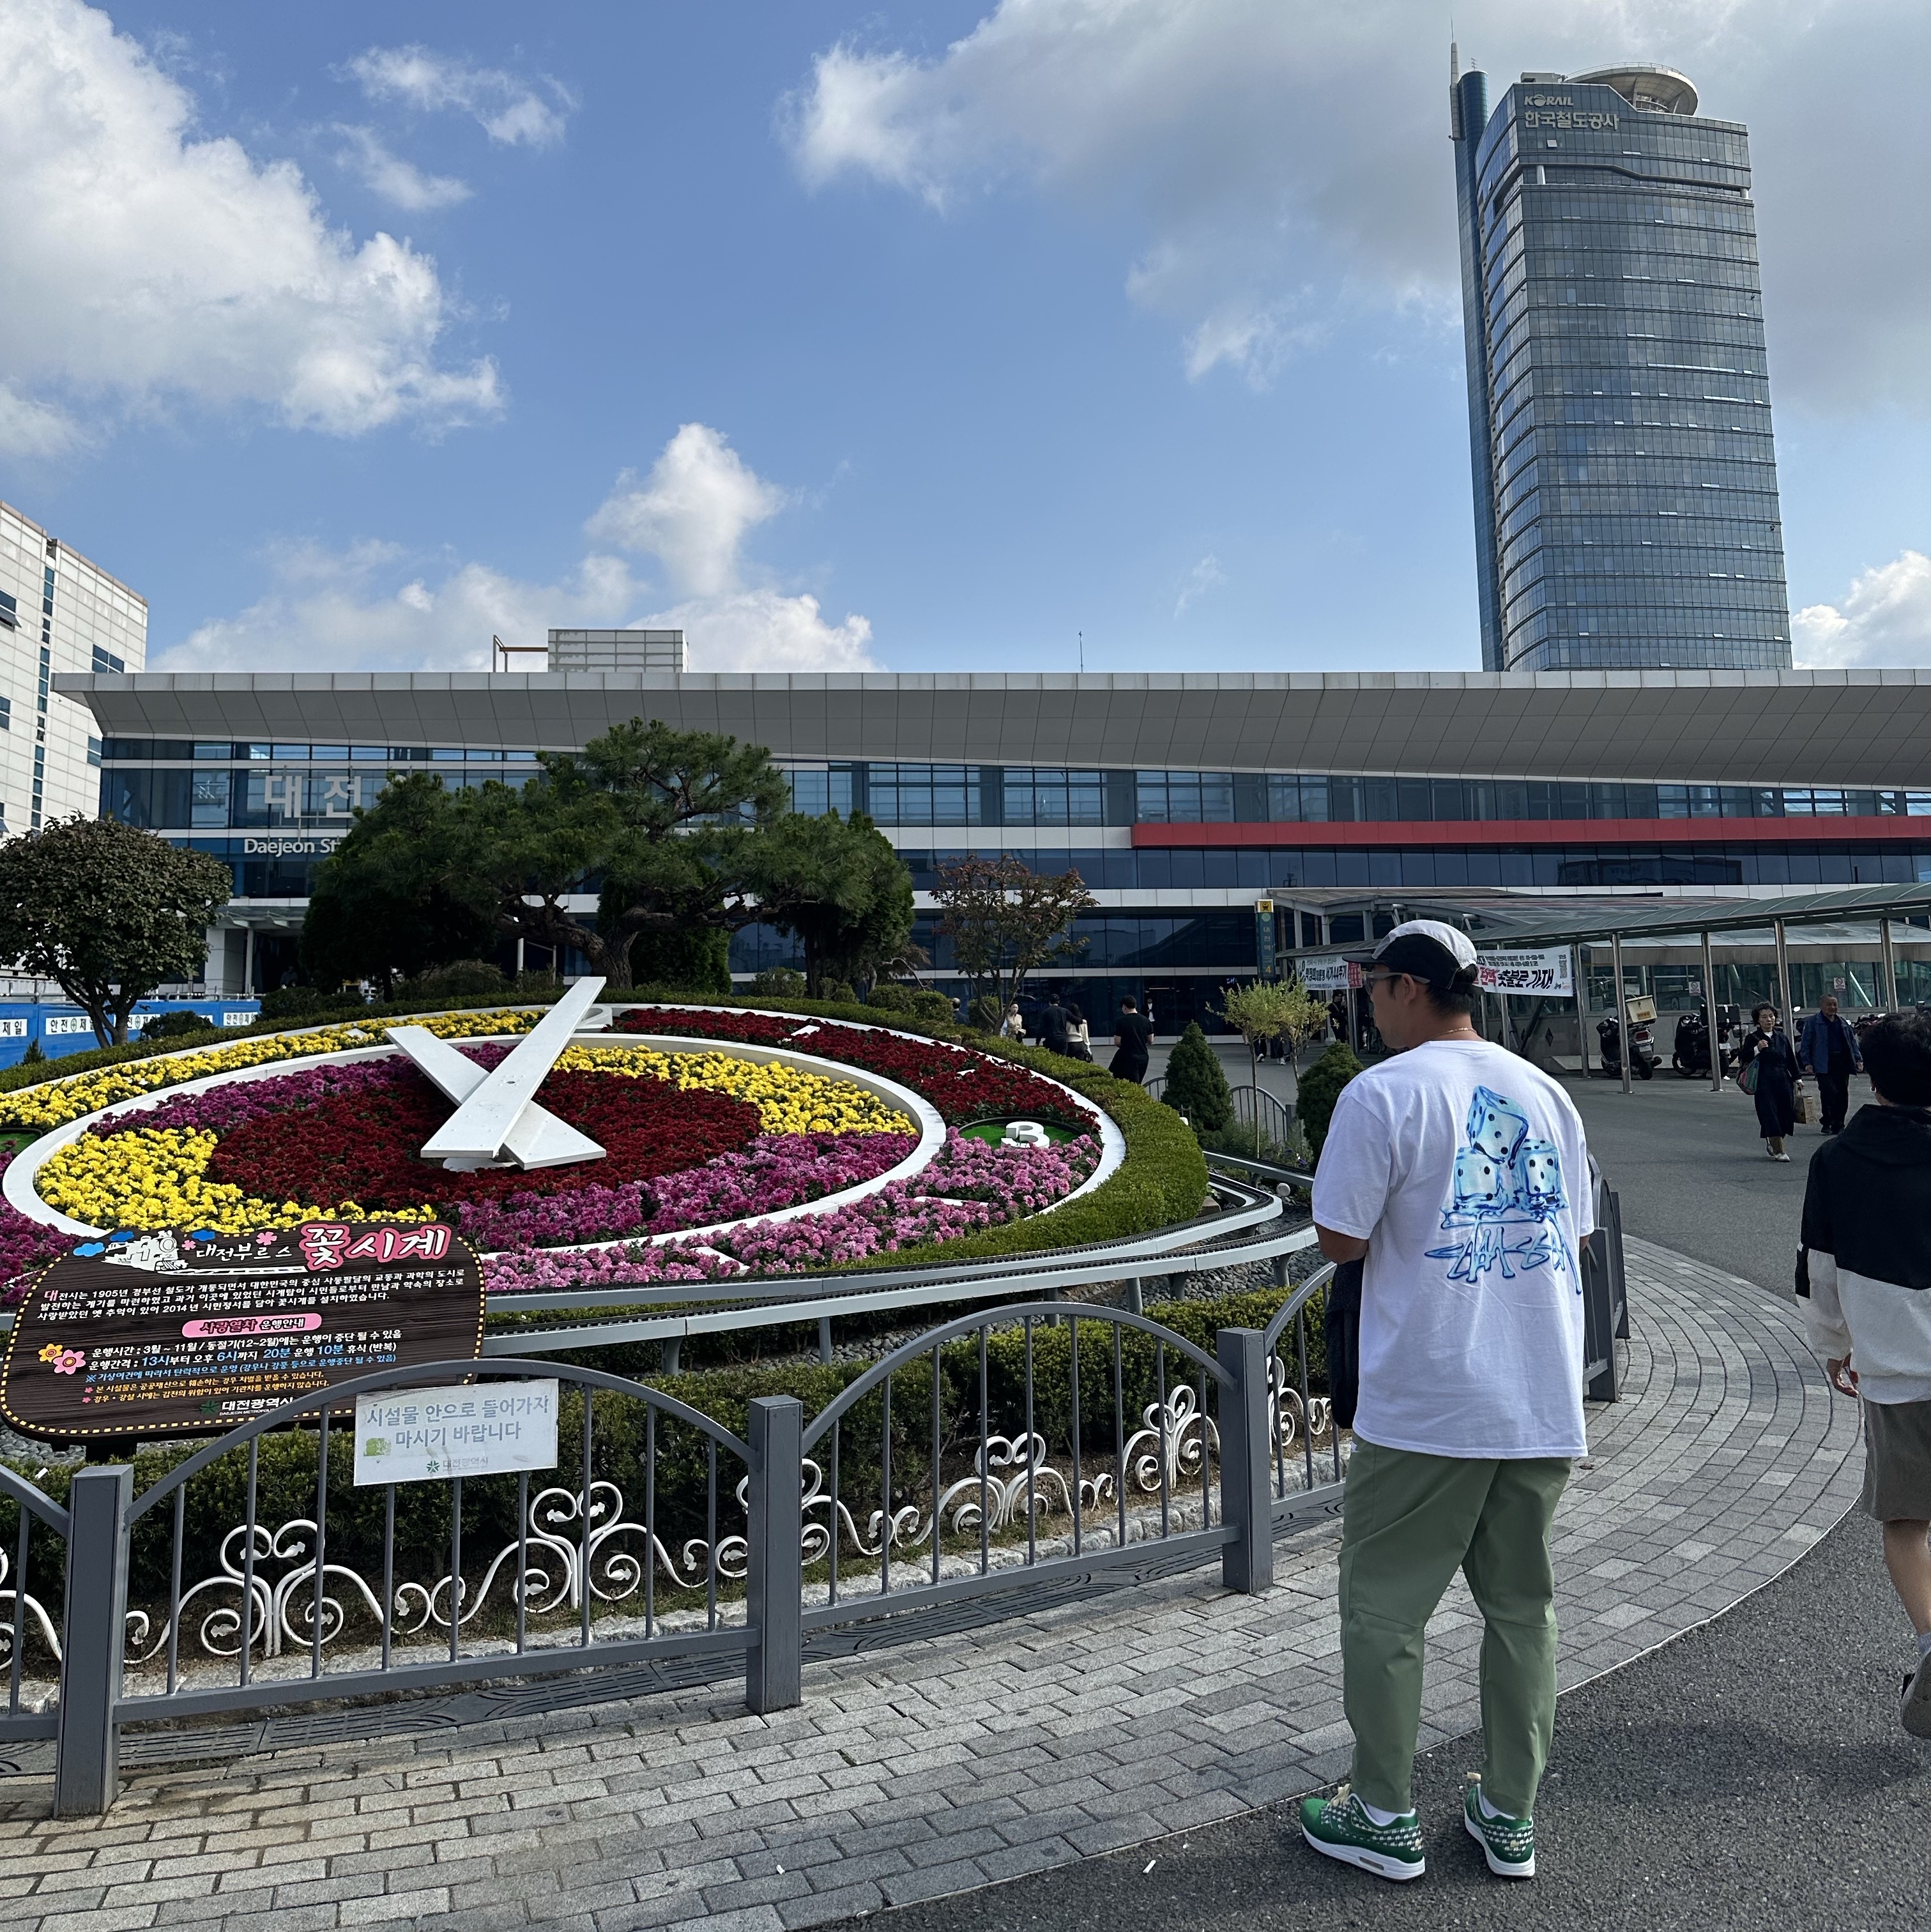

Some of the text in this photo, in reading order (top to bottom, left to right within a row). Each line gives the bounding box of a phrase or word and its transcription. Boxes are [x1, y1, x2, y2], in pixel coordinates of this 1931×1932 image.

[1524, 94, 1574, 107] KORAIL
[1524, 110, 1619, 130] 한국철도공사
[244, 839, 315, 857] Daejeon
[1265, 966, 1272, 974] 4
[3, 1021, 22, 1035] 제일
[50, 1019, 68, 1033] 안전
[1000, 1122, 1049, 1149] 3
[195, 1227, 445, 1266] 대전부르스 꽃시계
[40, 1277, 464, 1311] 발전하는 계기를 마련하였고 과거 이곳에 있었던 시계탑이 시민들로부터 만남과 약속의 장소로
[43, 1269, 465, 1302] 대전시는 1905년 경부선 철도가 개통되면서 대한민국의 중심 사통팔달의 교통과 과학의 도시로
[36, 1310, 88, 1321] 사랑받았던
[105, 1307, 135, 1317] 추억이
[139, 1305, 159, 1315] 있어
[202, 1300, 251, 1311] 시민정서를
[255, 1298, 275, 1308] 담아
[278, 1297, 316, 1307] 꽃시계를
[319, 1292, 390, 1305] 설치하였습니다.
[199, 1318, 305, 1334] 사랑열차 운행안내
[143, 1344, 161, 1355] 3월
[174, 1342, 197, 1352] 11월
[301, 1334, 332, 1344] 운행이
[334, 1332, 355, 1343] 중단
[369, 1330, 380, 1340] 수
[382, 1329, 402, 1340] 있음
[142, 1355, 190, 1367] 13시부터
[193, 1353, 214, 1364] 오후
[217, 1350, 257, 1362] 6시까지
[263, 1347, 291, 1358] 20분
[293, 1346, 314, 1357] 운행
[317, 1343, 344, 1355] 10분
[346, 1343, 367, 1353] 휴식
[369, 1342, 397, 1353] (반복)
[98, 1370, 142, 1381] 기상여건에
[144, 1367, 172, 1378] 따라서
[173, 1365, 217, 1376] 탄력적으로
[291, 1359, 316, 1369] 등으로
[365, 1355, 374, 1364] 수
[376, 1354, 397, 1364] 있음)
[105, 1382, 138, 1393] 시설물은
[139, 1380, 187, 1390] 공공재산으로
[281, 1372, 289, 1380] 수
[137, 1391, 160, 1400] 시에는
[222, 1396, 294, 1410] 대전광역시
[367, 1406, 419, 1427] 시설물
[425, 1402, 477, 1423] 안으로
[395, 1421, 522, 1449] 마시기 바랍니다
[443, 1457, 489, 1470] 대전광역시
